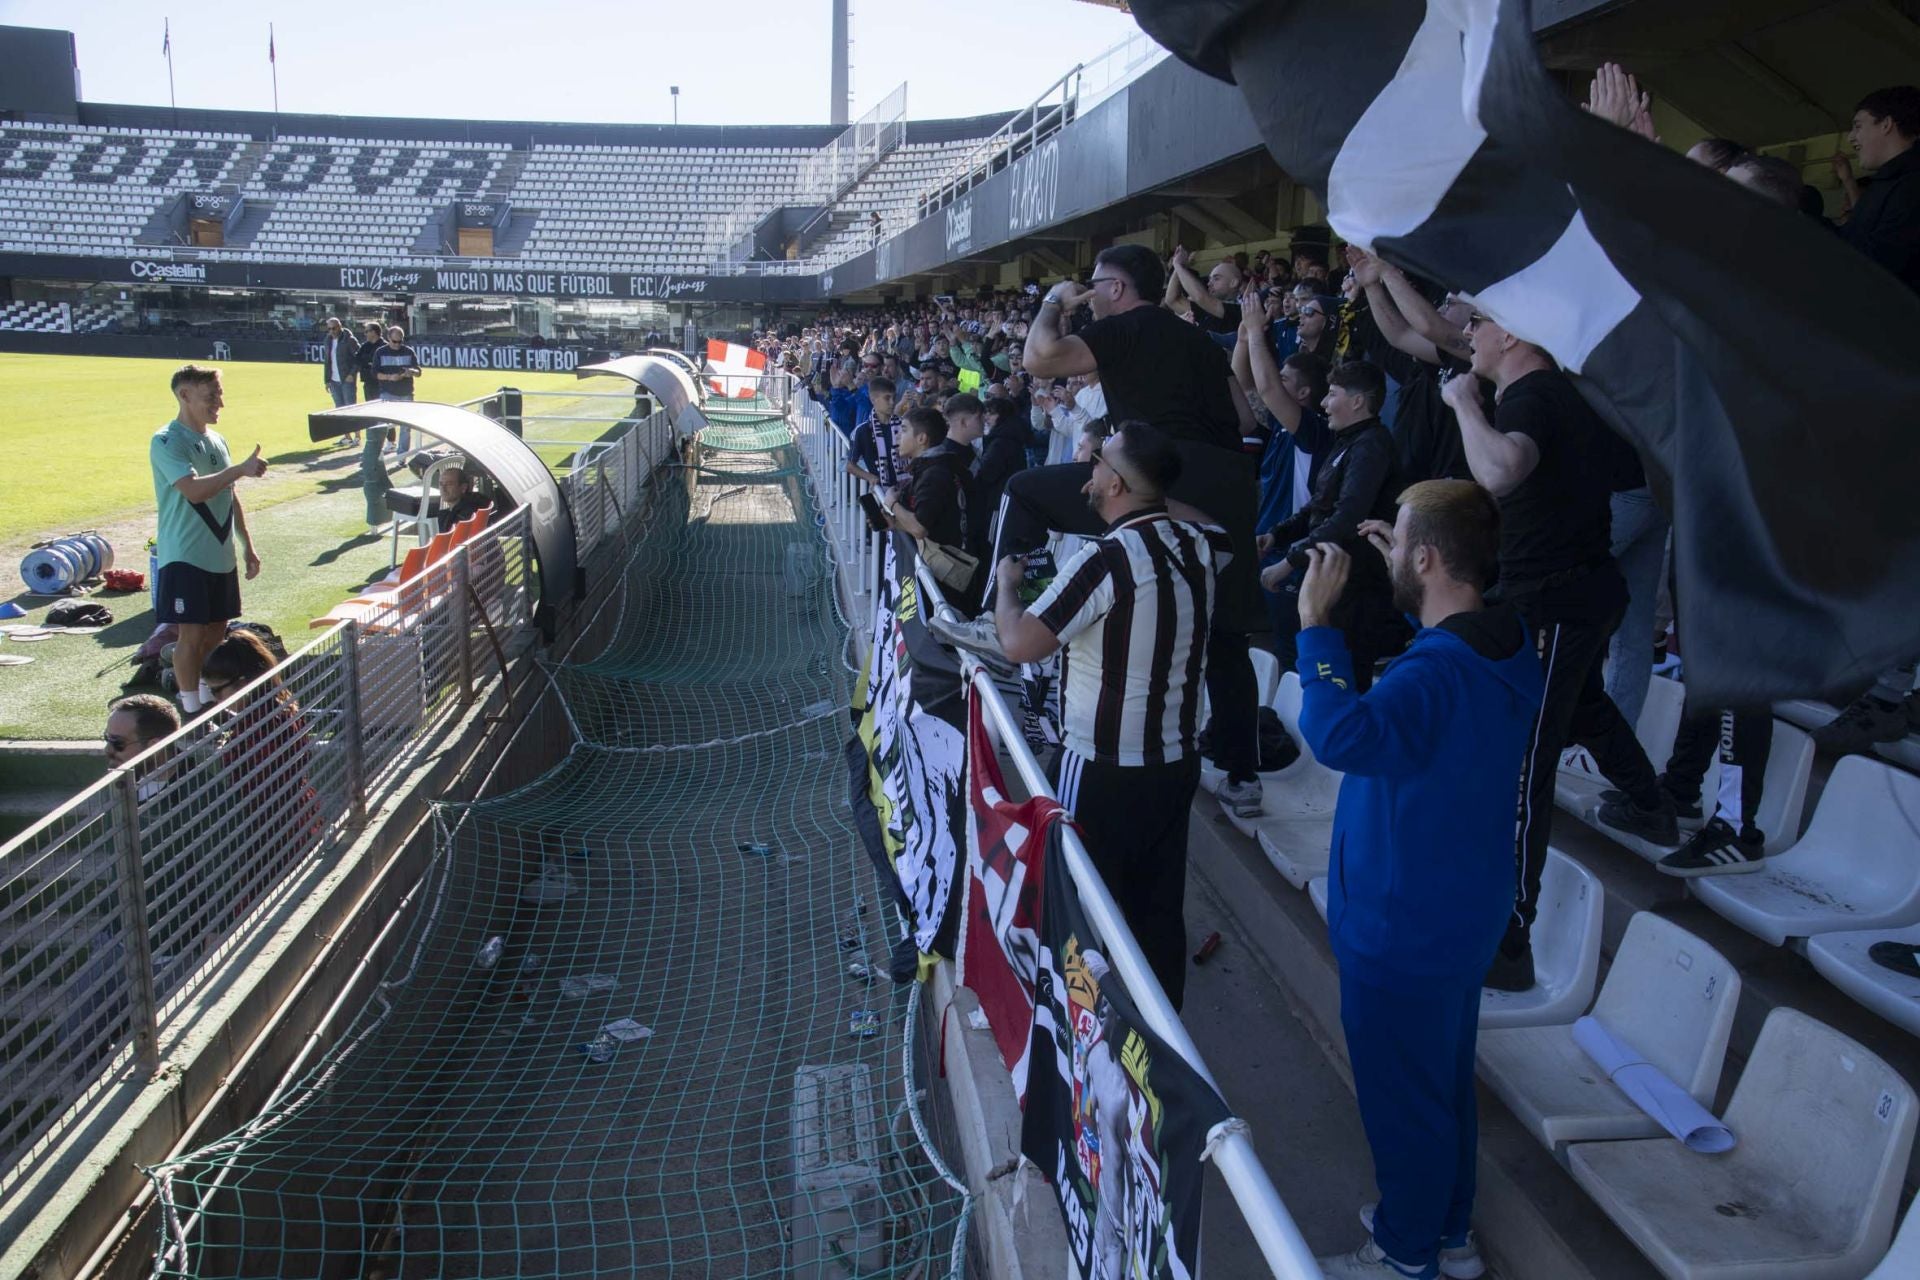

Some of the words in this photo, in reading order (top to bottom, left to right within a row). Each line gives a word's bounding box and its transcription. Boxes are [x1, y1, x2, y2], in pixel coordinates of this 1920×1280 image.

[146, 262, 205, 278] Castellini
[341, 268, 364, 287] FCC
[370, 268, 421, 290] Business
[437, 272, 487, 291] MUCHO
[493, 273, 523, 292] MAS
[527, 274, 555, 294] QUE
[630, 276, 653, 296] FCC
[658, 275, 708, 298] Business
[412, 345, 451, 367] UCHO
[455, 347, 489, 368] MAS
[493, 348, 522, 369] QUE
[210, 454, 217, 465] 8
